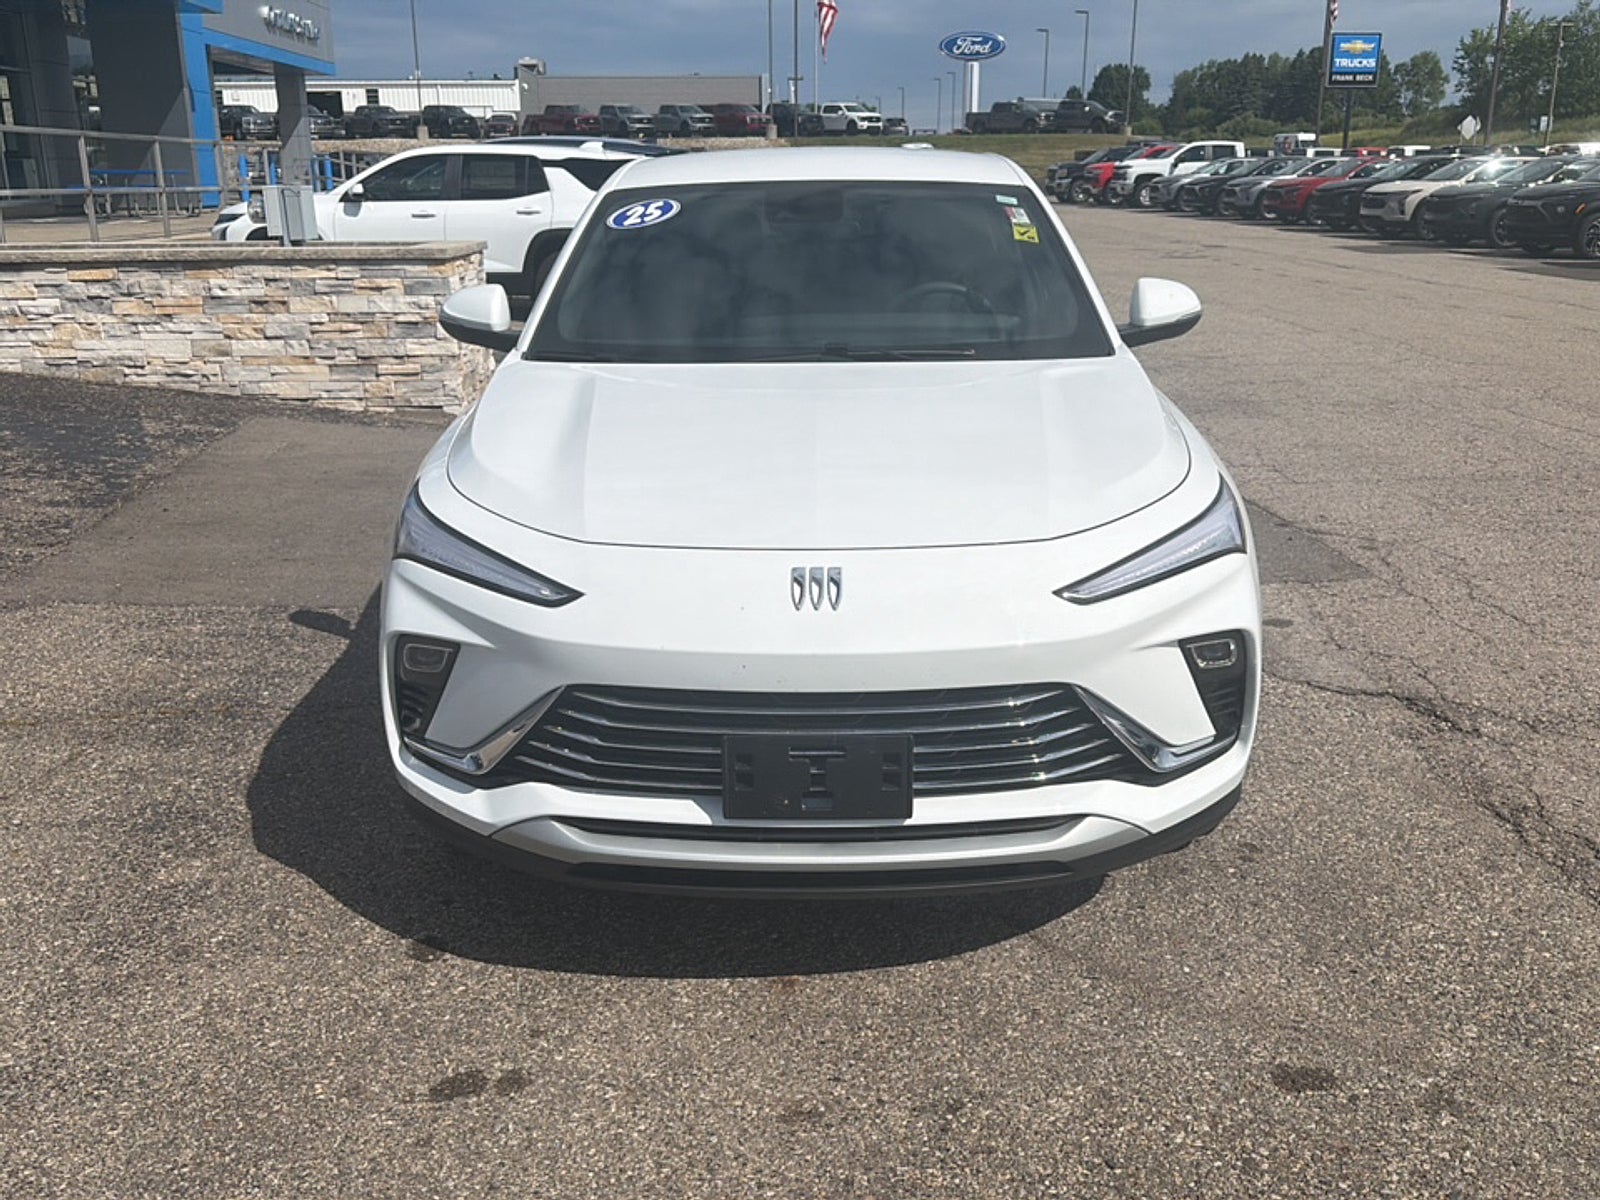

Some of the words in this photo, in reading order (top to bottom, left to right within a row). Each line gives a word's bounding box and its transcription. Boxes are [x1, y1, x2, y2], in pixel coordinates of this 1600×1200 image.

[953, 36, 993, 54] Ford
[1334, 58, 1376, 68] TRUCKS
[623, 201, 664, 226] 25
